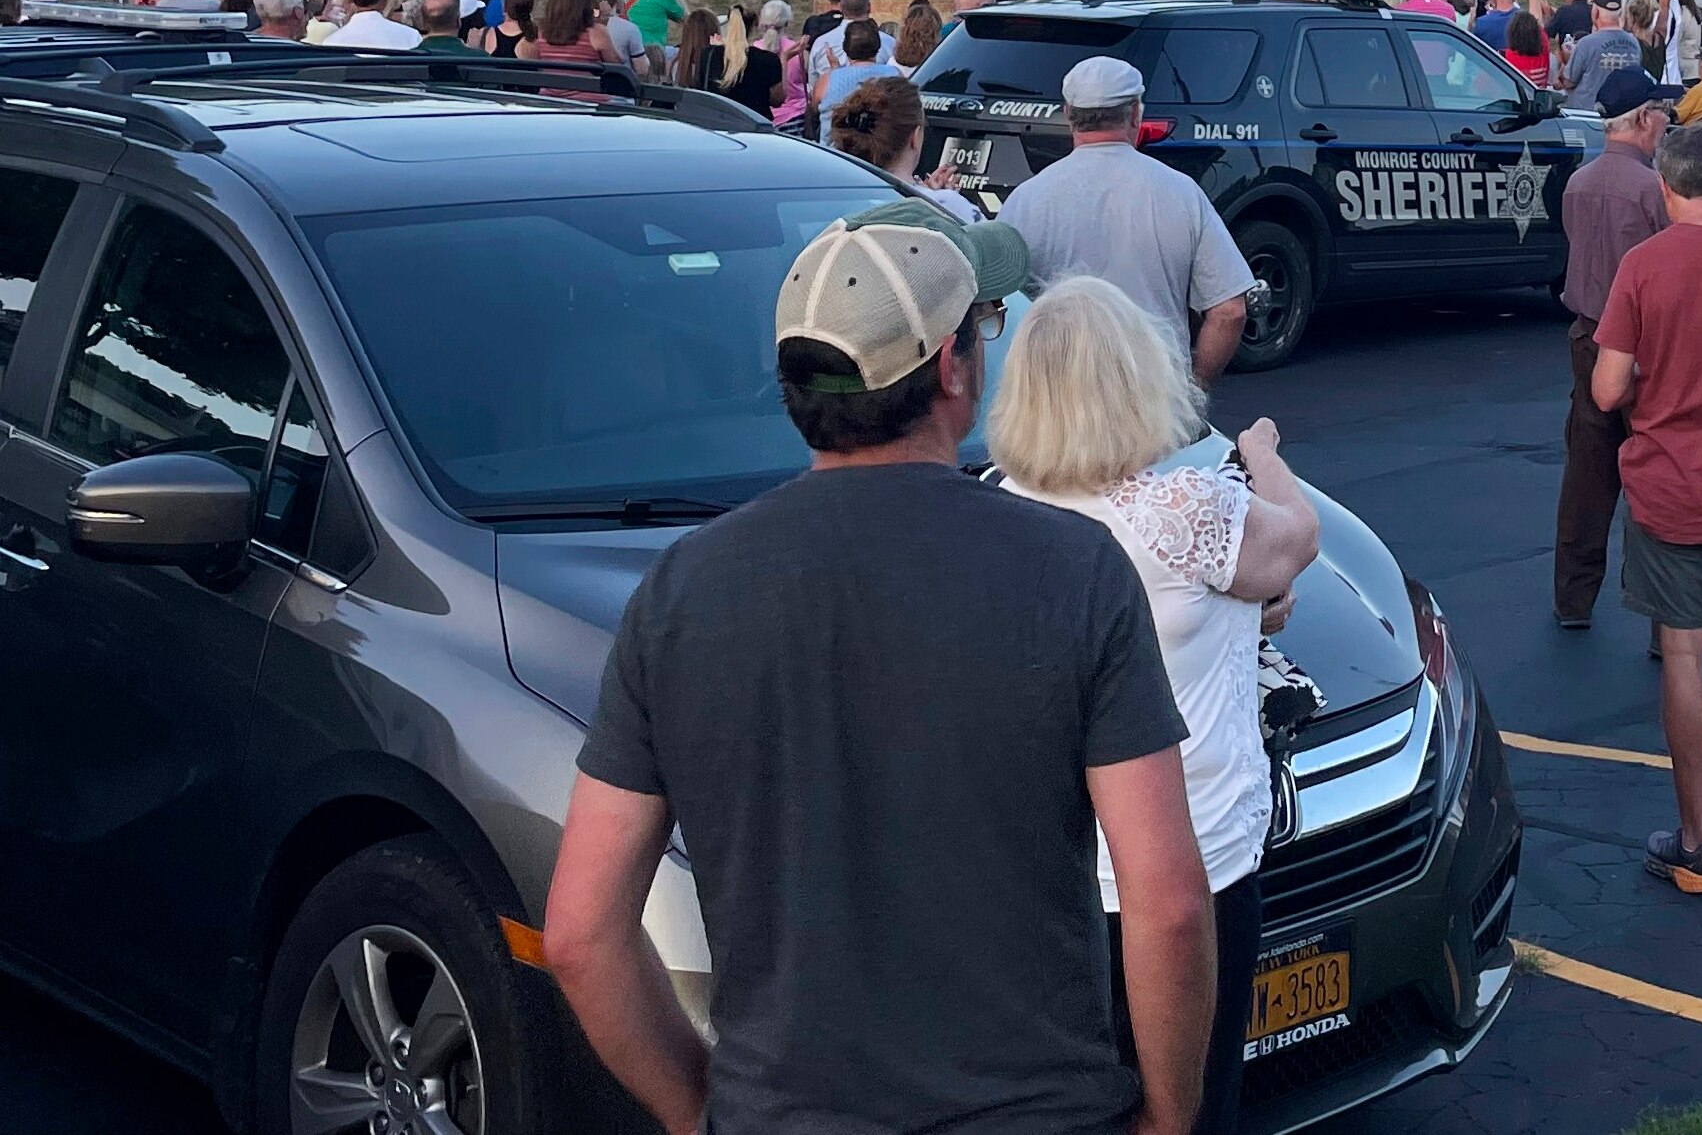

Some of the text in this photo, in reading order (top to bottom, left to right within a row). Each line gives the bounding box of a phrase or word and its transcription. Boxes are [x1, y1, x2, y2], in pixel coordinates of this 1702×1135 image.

[990, 100, 1061, 118] COUNTY
[1194, 123, 1259, 140] DIAL 911
[949, 148, 982, 166] 7013
[1355, 151, 1476, 170] MONROE COUNTY
[956, 174, 990, 190] RIFF
[1335, 169, 1508, 222] SHERIFF
[1276, 1013, 1351, 1049] HONDA
